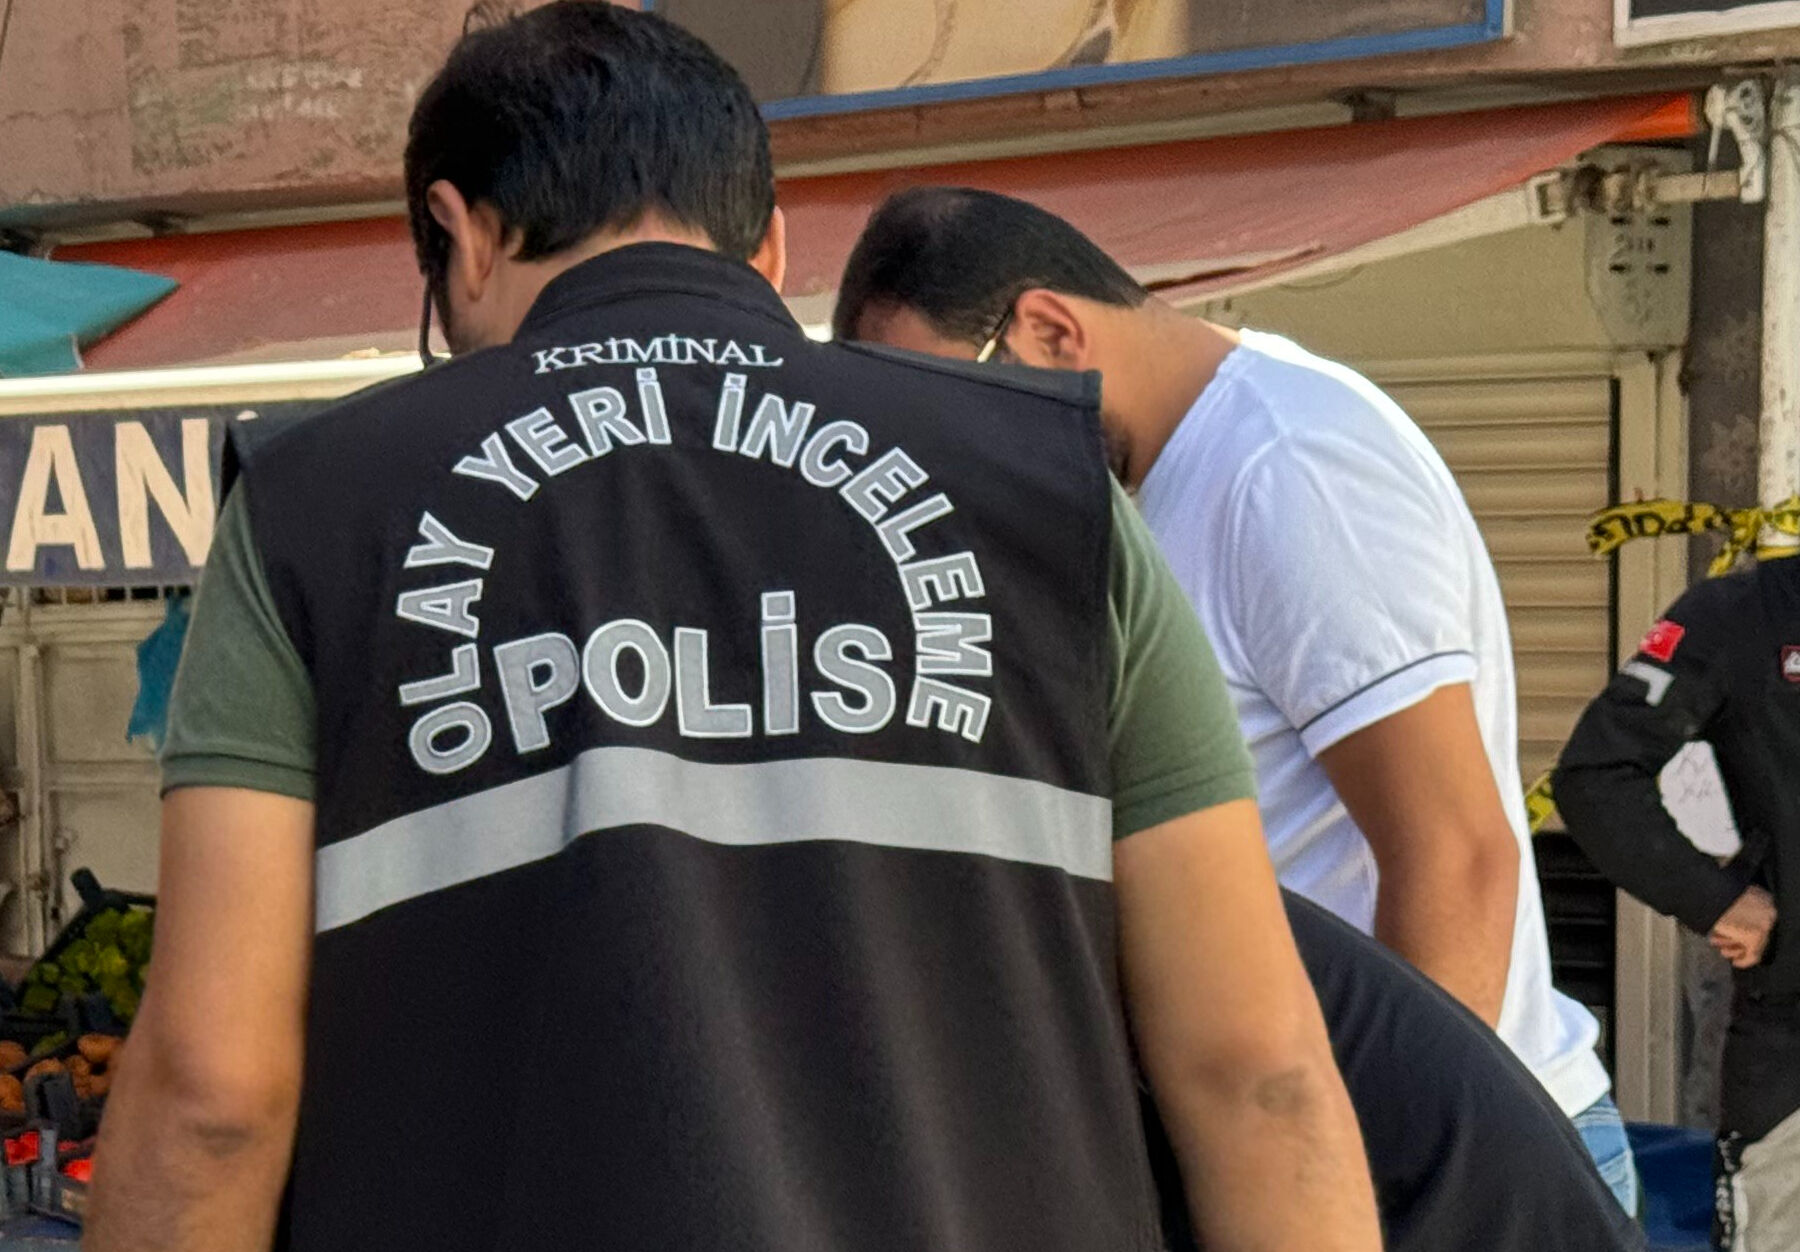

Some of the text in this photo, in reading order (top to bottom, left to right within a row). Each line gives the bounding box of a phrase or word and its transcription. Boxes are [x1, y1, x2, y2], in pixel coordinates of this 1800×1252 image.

[531, 333, 784, 374] KRİMİNAL
[396, 367, 993, 775] OLAY YERİ İNCELEME
[493, 590, 897, 754] POLİS
